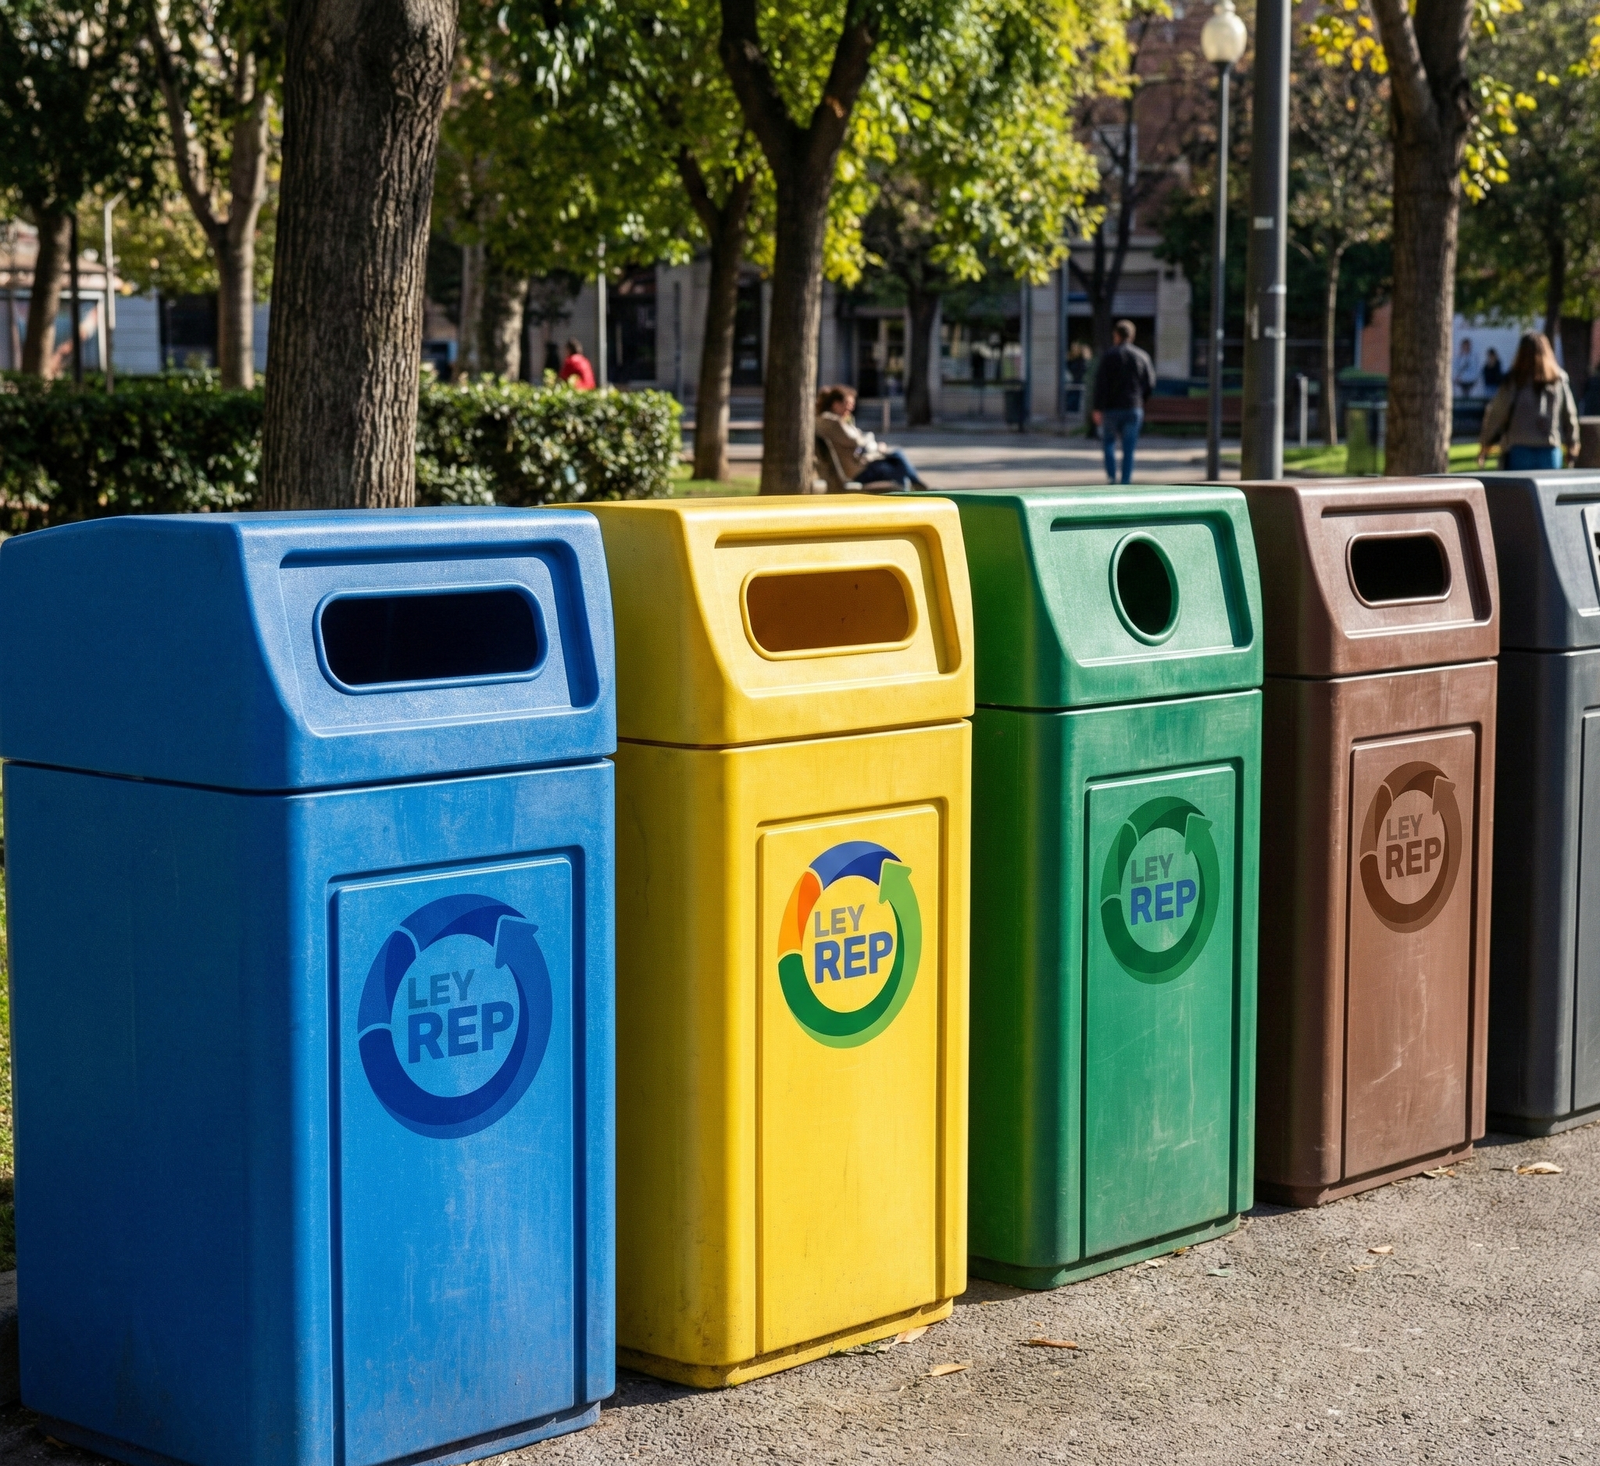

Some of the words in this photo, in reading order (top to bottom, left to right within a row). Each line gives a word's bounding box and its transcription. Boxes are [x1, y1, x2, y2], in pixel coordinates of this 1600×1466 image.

[1386, 813, 1423, 841] LEY
[1131, 853, 1174, 884] LEY
[1386, 837, 1441, 880] REP
[815, 904, 865, 938] LEY
[1131, 879, 1196, 925] REP
[815, 931, 893, 984] REP
[408, 968, 475, 1009] LEY
[408, 1001, 514, 1064] REP
